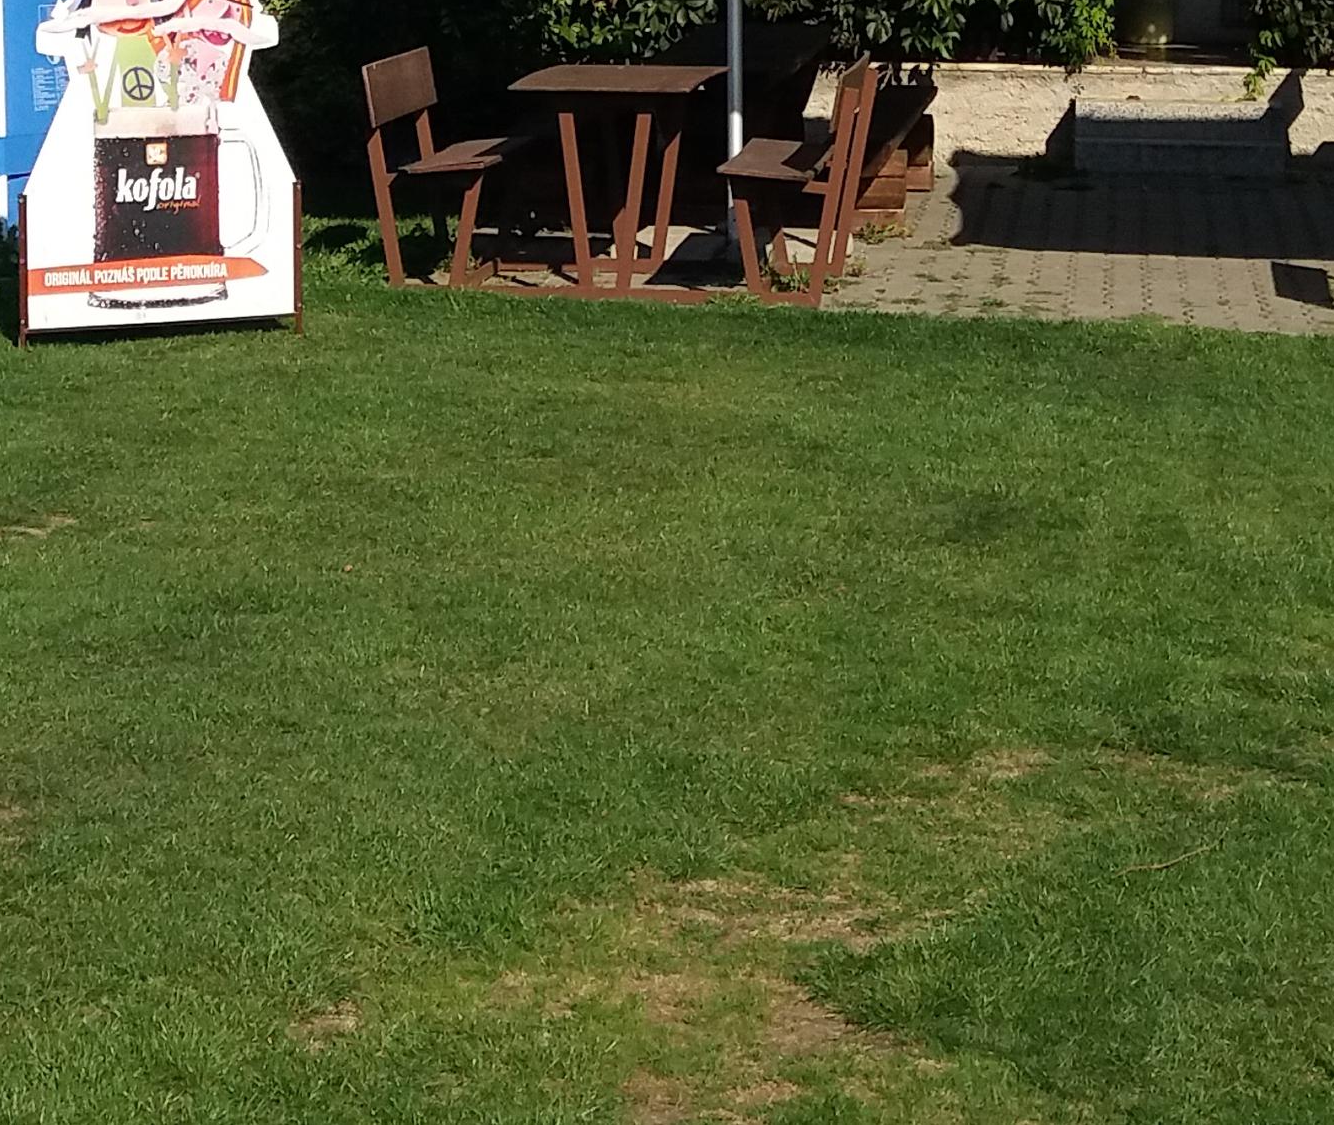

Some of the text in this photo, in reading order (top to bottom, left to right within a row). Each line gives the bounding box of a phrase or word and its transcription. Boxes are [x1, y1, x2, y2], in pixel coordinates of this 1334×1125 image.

[115, 167, 197, 212] kofola
[156, 194, 202, 216] original
[43, 261, 229, 287] ORIGINÁL POZNÁŠ PODLE PĚNOKNÍRA
